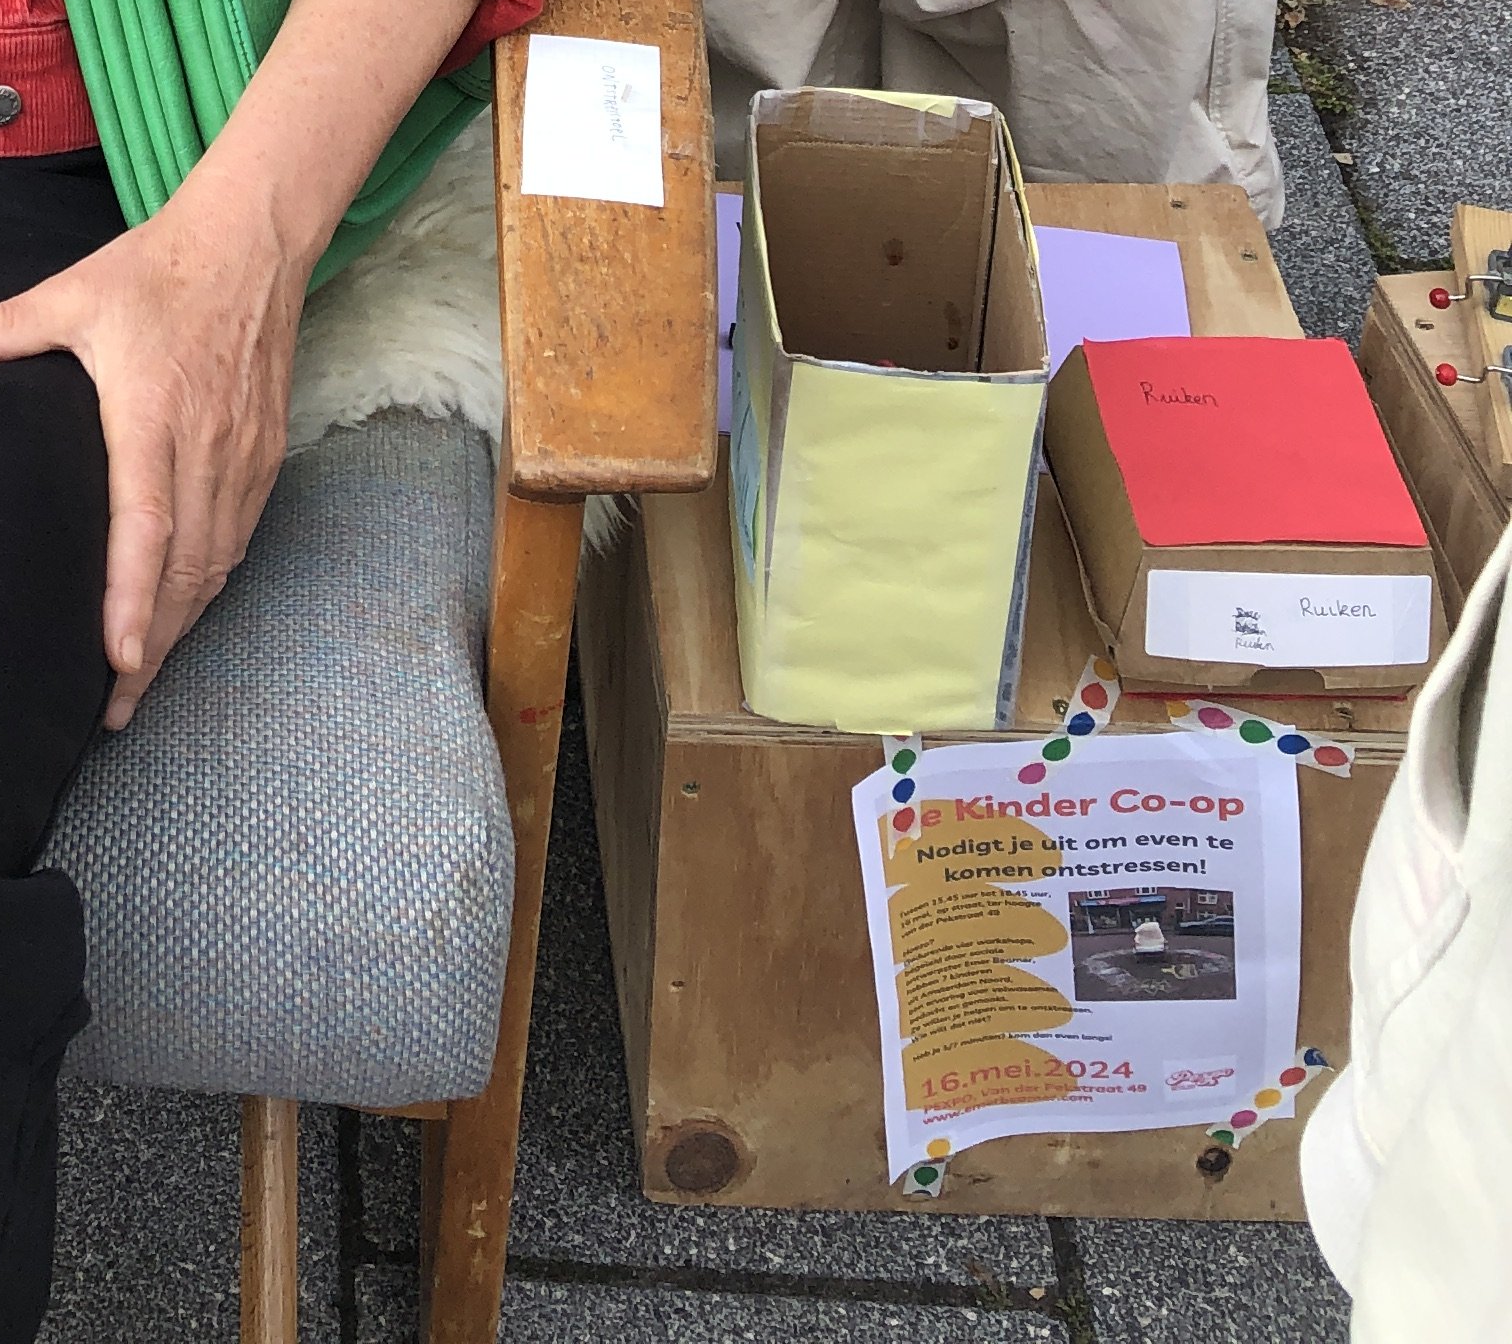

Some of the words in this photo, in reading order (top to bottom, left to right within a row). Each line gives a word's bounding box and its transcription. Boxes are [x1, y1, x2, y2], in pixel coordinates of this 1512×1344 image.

[1140, 381, 1219, 407] Ruiken
[1299, 597, 1377, 618] Ruiken
[954, 792, 1098, 822] Kinder
[1109, 788, 1245, 822] Co-op
[917, 837, 1005, 864] Nodigt
[1008, 835, 1034, 856] je
[1041, 834, 1079, 852] uit
[1085, 834, 1128, 851] om
[1135, 832, 1199, 849] even
[1206, 833, 1234, 851] te
[944, 863, 1034, 883] komen
[1041, 859, 1208, 880] ontstressen!
[921, 1059, 1134, 1098] 16.mei.2024
[1127, 1084, 1147, 1093] 49
